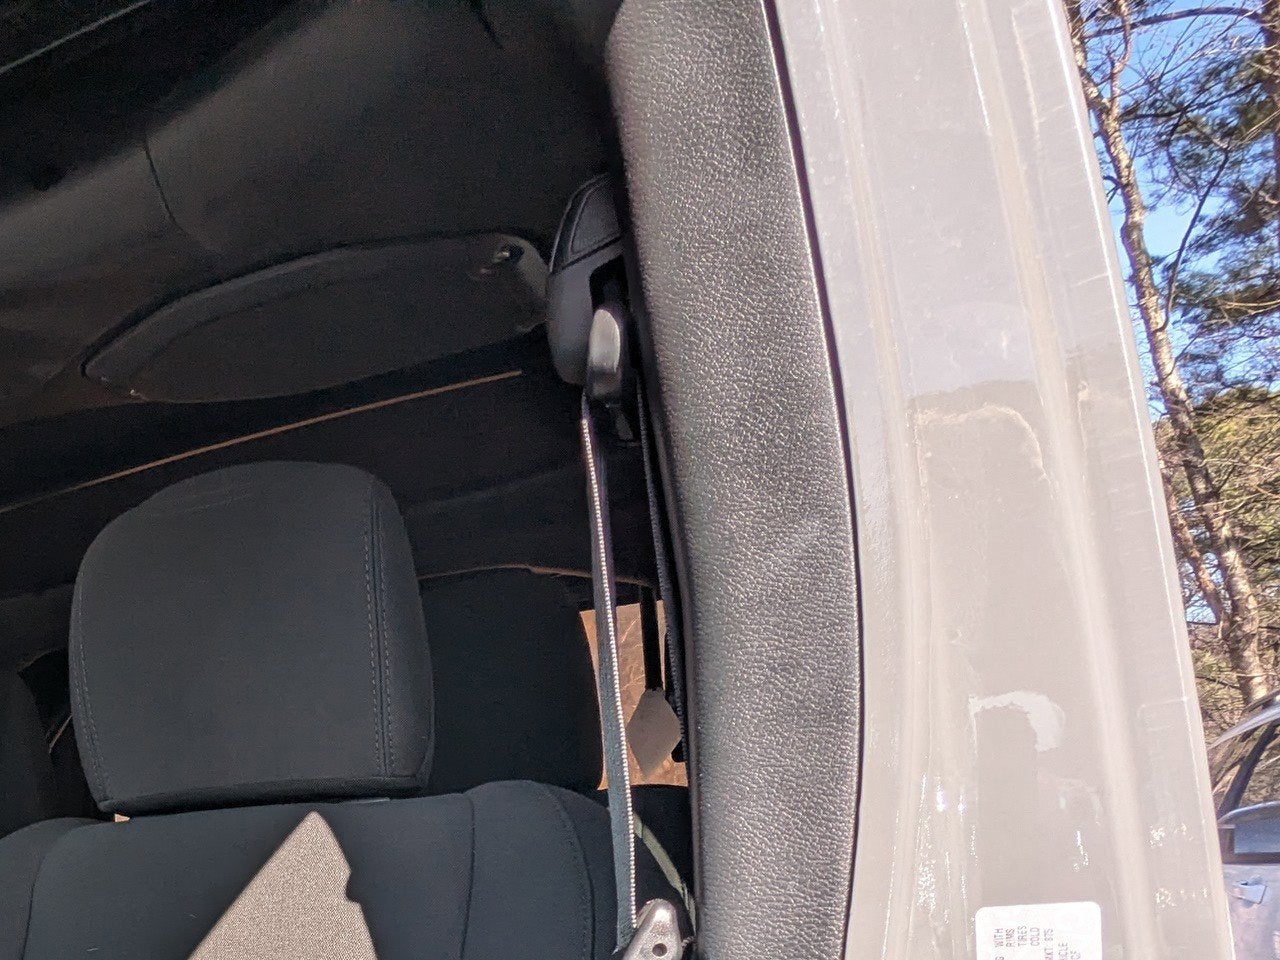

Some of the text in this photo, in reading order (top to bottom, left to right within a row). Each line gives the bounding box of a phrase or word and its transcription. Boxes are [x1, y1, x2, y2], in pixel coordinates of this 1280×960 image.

[994, 928, 1004, 948] WITH
[1006, 928, 1014, 947] RIMS
[1018, 926, 1028, 946] TIRES
[1030, 928, 1040, 946] COLD
[1070, 950, 1080, 960] OF
